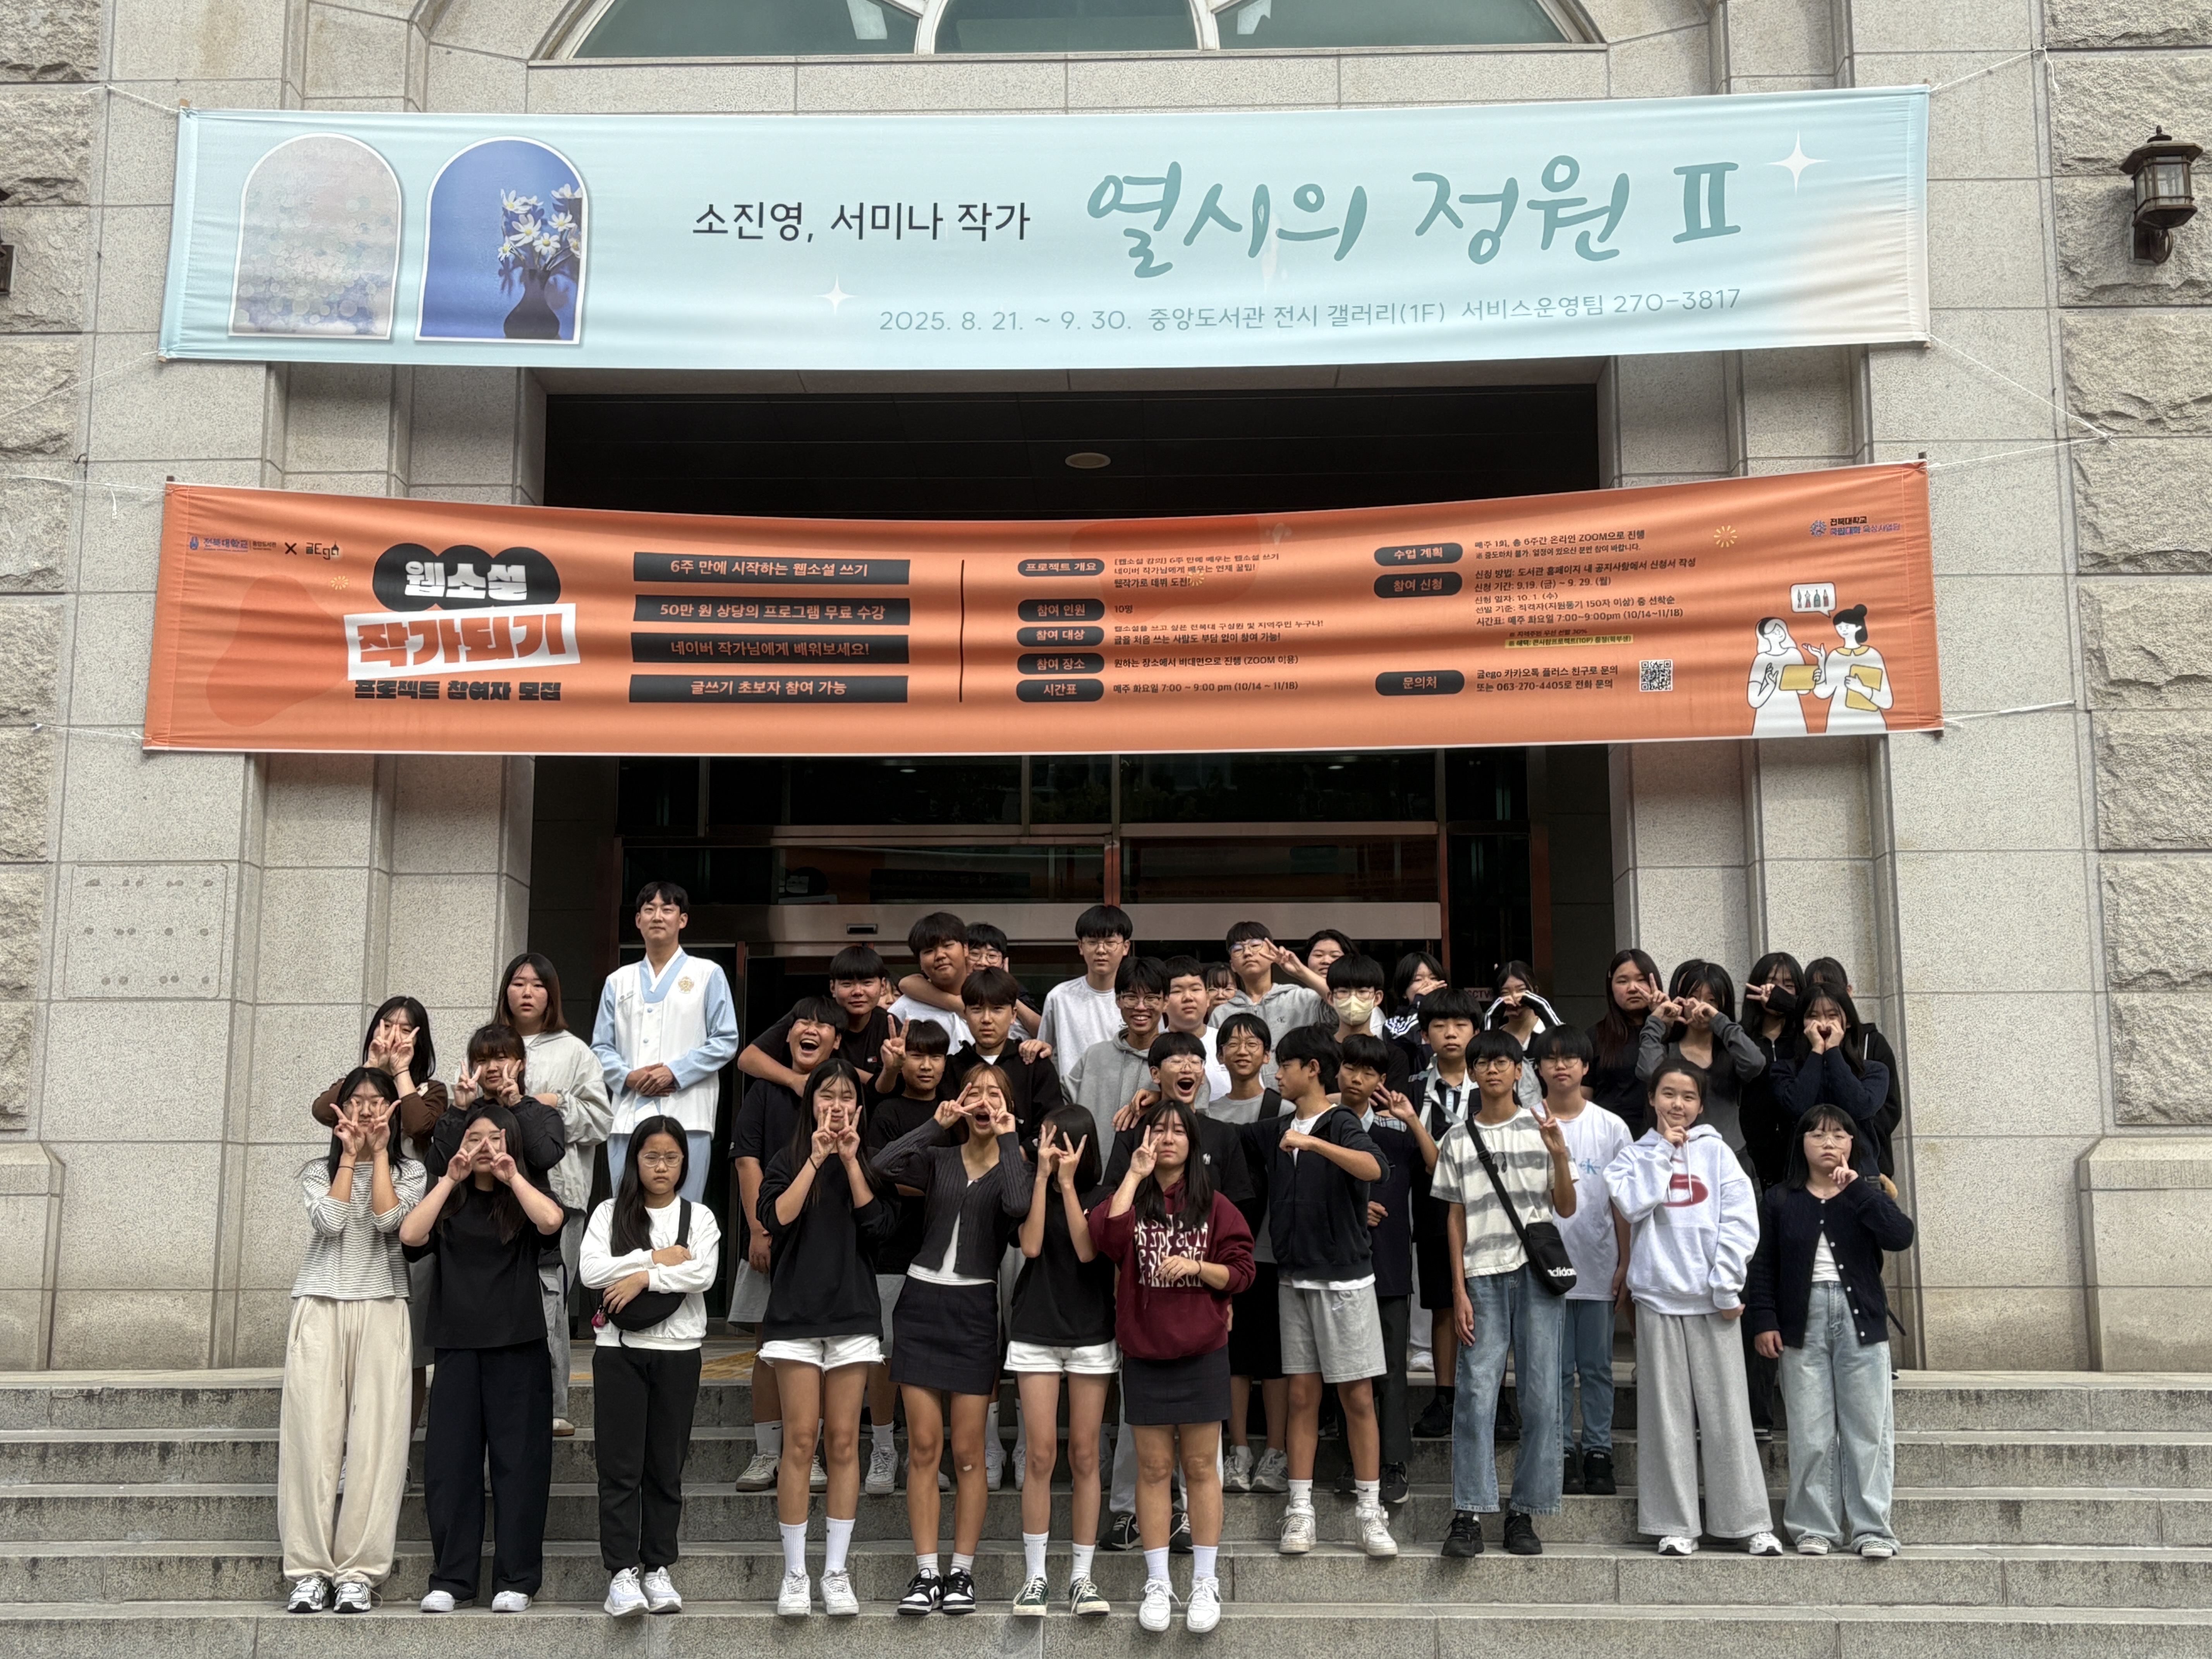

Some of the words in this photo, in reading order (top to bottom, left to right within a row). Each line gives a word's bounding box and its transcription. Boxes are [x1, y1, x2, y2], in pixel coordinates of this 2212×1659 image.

[693, 202, 812, 243] 소진영,
[831, 202, 943, 240] 서미나
[958, 202, 1030, 241] 작가
[1412, 155, 1630, 265] 정원
[879, 311, 951, 331] 2025.
[961, 311, 982, 331] 8.
[992, 311, 1023, 331] 21.
[1061, 311, 1081, 330] 9.
[1092, 310, 1131, 330] 30.
[1149, 307, 1265, 331] 중앙도서관
[1273, 305, 1317, 328] 전시
[1327, 302, 1445, 326] 갤러리(1F)
[1462, 294, 1604, 321] 서비스운영팀
[1614, 288, 1740, 314] 270-3817
[1579, 531, 1625, 542] ZOOM으로
[1394, 549, 1416, 560] 수업
[1420, 547, 1443, 558] 계획
[670, 560, 694, 574] 6주
[699, 560, 727, 575] 만에
[732, 562, 788, 576] 시작하는
[793, 563, 835, 577] 웹소설
[839, 564, 867, 577] 쓰기
[1026, 563, 1070, 572] 프로젝트
[1074, 562, 1096, 571] 개요
[1475, 570, 1492, 579] 신청
[1495, 568, 1515, 578] 방법:
[1518, 567, 1544, 577] 도서관
[1547, 565, 1580, 576] 홈페이지
[1584, 564, 1592, 573] 내
[1650, 558, 1676, 569] 신청서
[1679, 558, 1696, 567] 작성
[405, 560, 527, 601] 웹소설
[1394, 579, 1415, 592] 참여
[1420, 578, 1443, 591] 신청
[1475, 583, 1491, 592] 신청
[1494, 582, 1514, 591] 기간:
[1541, 580, 1556, 589] (금)
[1595, 577, 1611, 586] (월)
[1115, 605, 1133, 614] 10명
[1586, 599, 1610, 608] 150자
[660, 604, 694, 617] 50만
[698, 604, 712, 617] 원
[716, 604, 759, 618] 상당의
[764, 605, 819, 619] 프로그램
[824, 605, 852, 619] 무료
[857, 605, 885, 620] 수강
[1037, 605, 1059, 617] 참여
[1064, 604, 1085, 616] 인원
[1477, 617, 1505, 626] 시간표:
[1508, 615, 1525, 625] 매주
[1528, 614, 1554, 624] 화요일
[1556, 612, 1620, 622] 7:00~9:00pm
[1623, 608, 1683, 620] (10/14~11/18)
[357, 613, 567, 668] 작가되기
[1036, 630, 1058, 641] 참여
[1062, 629, 1085, 641] 대상
[1153, 635, 1170, 644] 쓰는
[671, 641, 713, 656] 네이버
[718, 641, 789, 656] 작가님에게
[794, 642, 869, 656] 배워보세요!
[1037, 658, 1058, 670] 참여
[1063, 658, 1085, 670] 장소
[1115, 658, 1140, 668] 원하는
[1143, 658, 1176, 667] 장소에서
[1179, 657, 1221, 666] 비대면으로
[1244, 656, 1275, 664] (ZOOM
[1278, 655, 1298, 665] 이용)
[1504, 668, 1539, 678] 카카오톡
[1542, 667, 1568, 677] 플러스
[1571, 666, 1598, 676] 친구로
[1601, 665, 1618, 675] 문의
[691, 681, 733, 695] 글쓰기
[738, 681, 781, 695] 초보자
[785, 681, 813, 695] 참여
[818, 681, 847, 695] 가능
[1113, 684, 1130, 694] 매주
[1133, 684, 1158, 693] 화요일
[1162, 684, 1182, 692] 7:00
[1194, 683, 1214, 691] 9:00
[1218, 684, 1231, 692] pm
[1234, 682, 1261, 692] (10/14
[1274, 681, 1298, 690] 11/18)
[1403, 676, 1437, 689] 문의처
[1477, 683, 1494, 692] 또는
[1496, 680, 1572, 691] 063-270-4405로
[1575, 680, 1592, 689] 전화
[1596, 678, 1613, 689] 문의
[355, 680, 440, 699] 프로젝트
[448, 681, 511, 701] 참여자
[519, 682, 561, 701] 모집
[1044, 684, 1077, 696] 시간표
